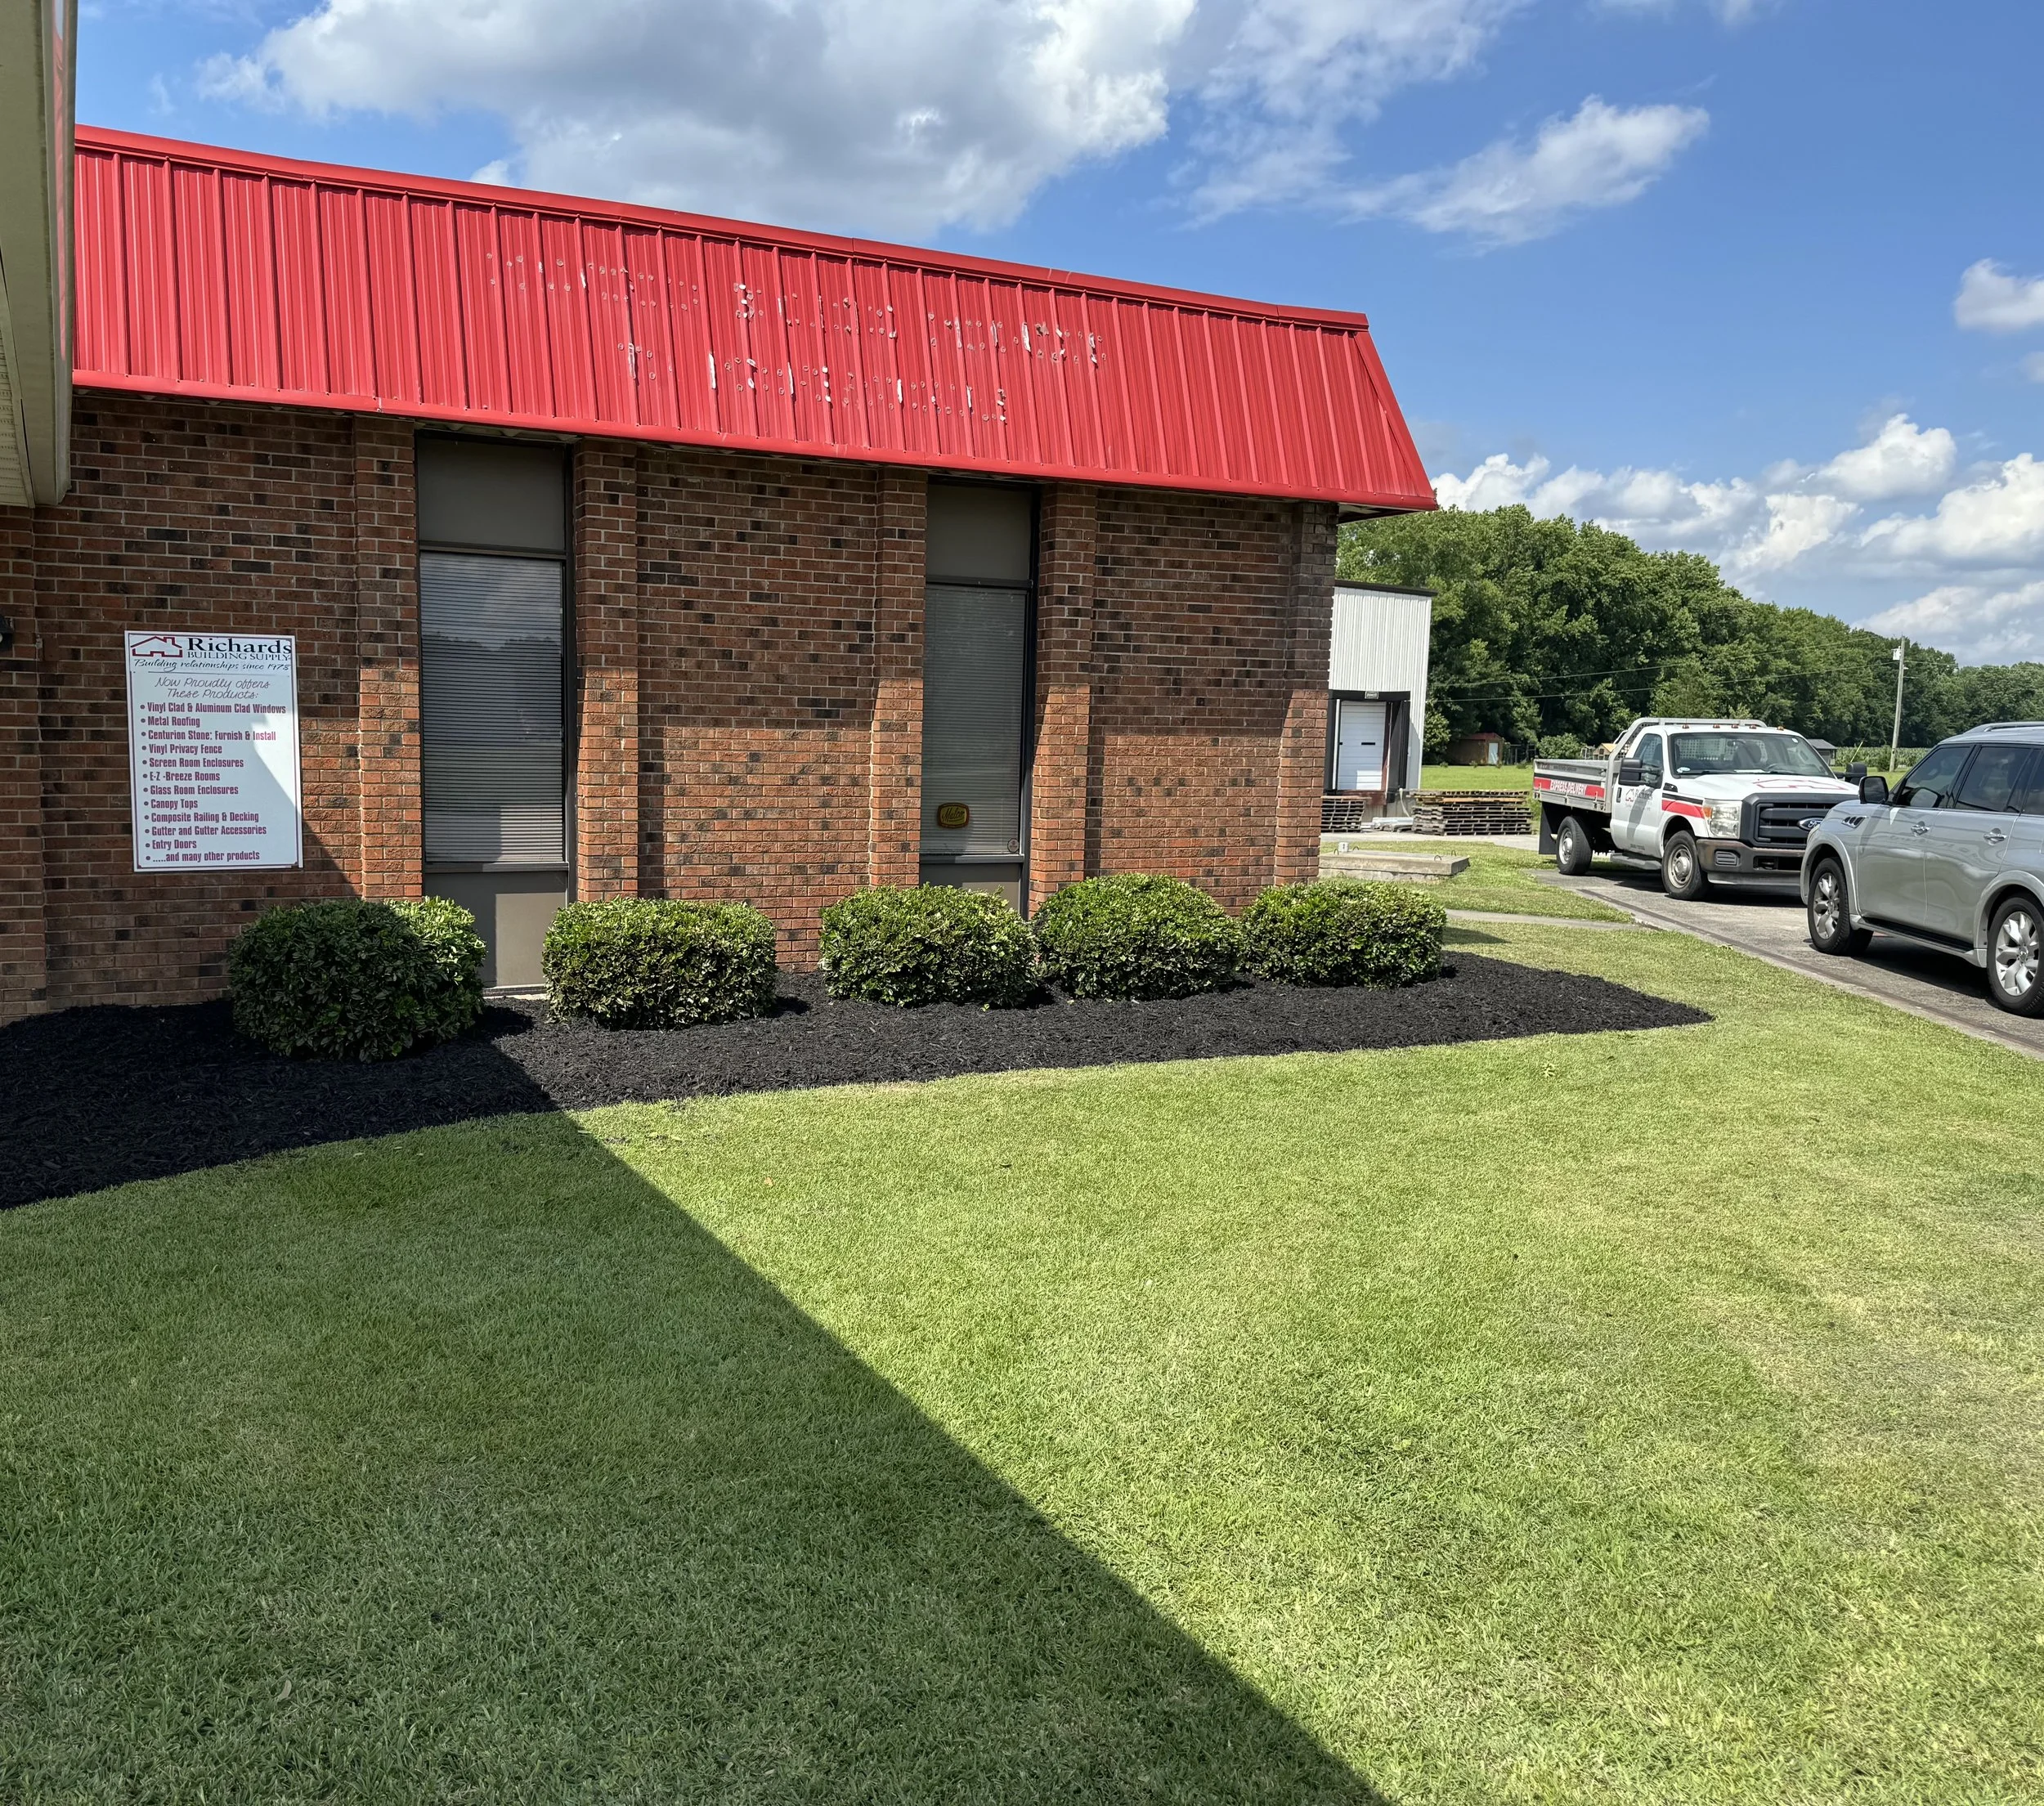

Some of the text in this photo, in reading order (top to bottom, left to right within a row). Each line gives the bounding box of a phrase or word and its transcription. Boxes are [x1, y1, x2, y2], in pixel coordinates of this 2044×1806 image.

[187, 638, 292, 654] Richards
[187, 652, 247, 660] BUILDING
[134, 659, 177, 672] Building
[181, 660, 239, 670] relationships
[155, 677, 271, 692] Now Proudly offers
[167, 688, 258, 699] These Products:
[147, 702, 285, 714] Vinyl Clad & Aluminum Clad Windows
[148, 716, 199, 728] Metal Roofing
[148, 730, 276, 741] Centurion Stone: Furnish & Install
[150, 744, 222, 755] Vinyl Privacy Fence
[150, 758, 244, 767] Screen Room Enclosures
[150, 772, 160, 781] E-Z
[195, 772, 220, 781] Rooms
[150, 785, 239, 795] Glass Room Enclosures
[151, 799, 198, 809] Canopy Tops
[151, 812, 258, 823] Composite Railing & Decking
[152, 825, 267, 836] Gutter and Gutter Accessories
[152, 840, 196, 850] Entry Doors
[182, 853, 201, 863] many
[204, 852, 224, 861] other
[227, 850, 259, 862] products
